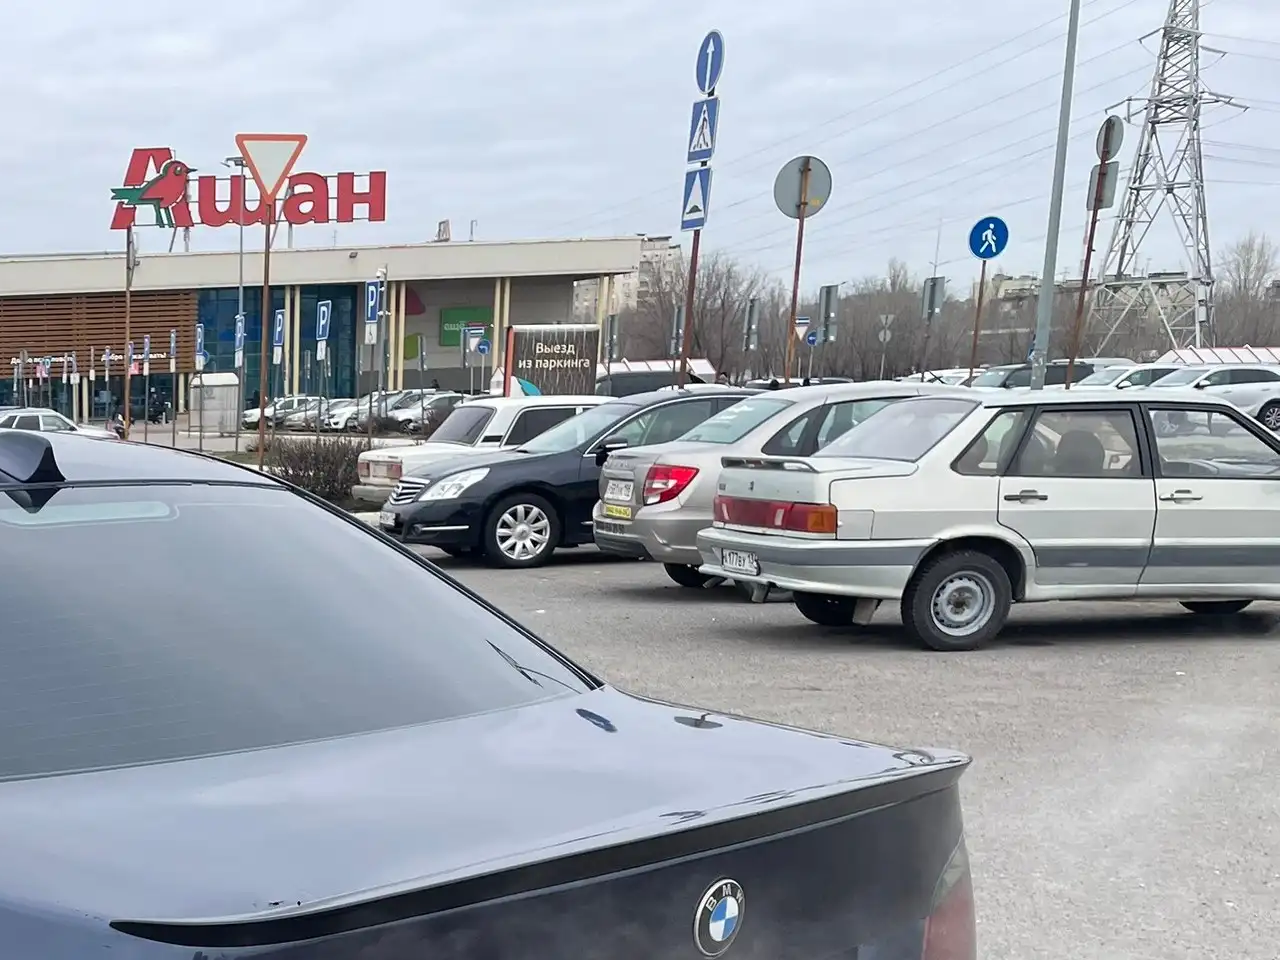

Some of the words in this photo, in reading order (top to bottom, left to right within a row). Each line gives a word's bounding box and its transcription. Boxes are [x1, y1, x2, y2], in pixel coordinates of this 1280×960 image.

[110, 147, 387, 229] Ашан
[535, 342, 576, 355] Выезд
[518, 359, 532, 369] из
[535, 358, 590, 371] паркинга
[705, 883, 745, 912] BMW
